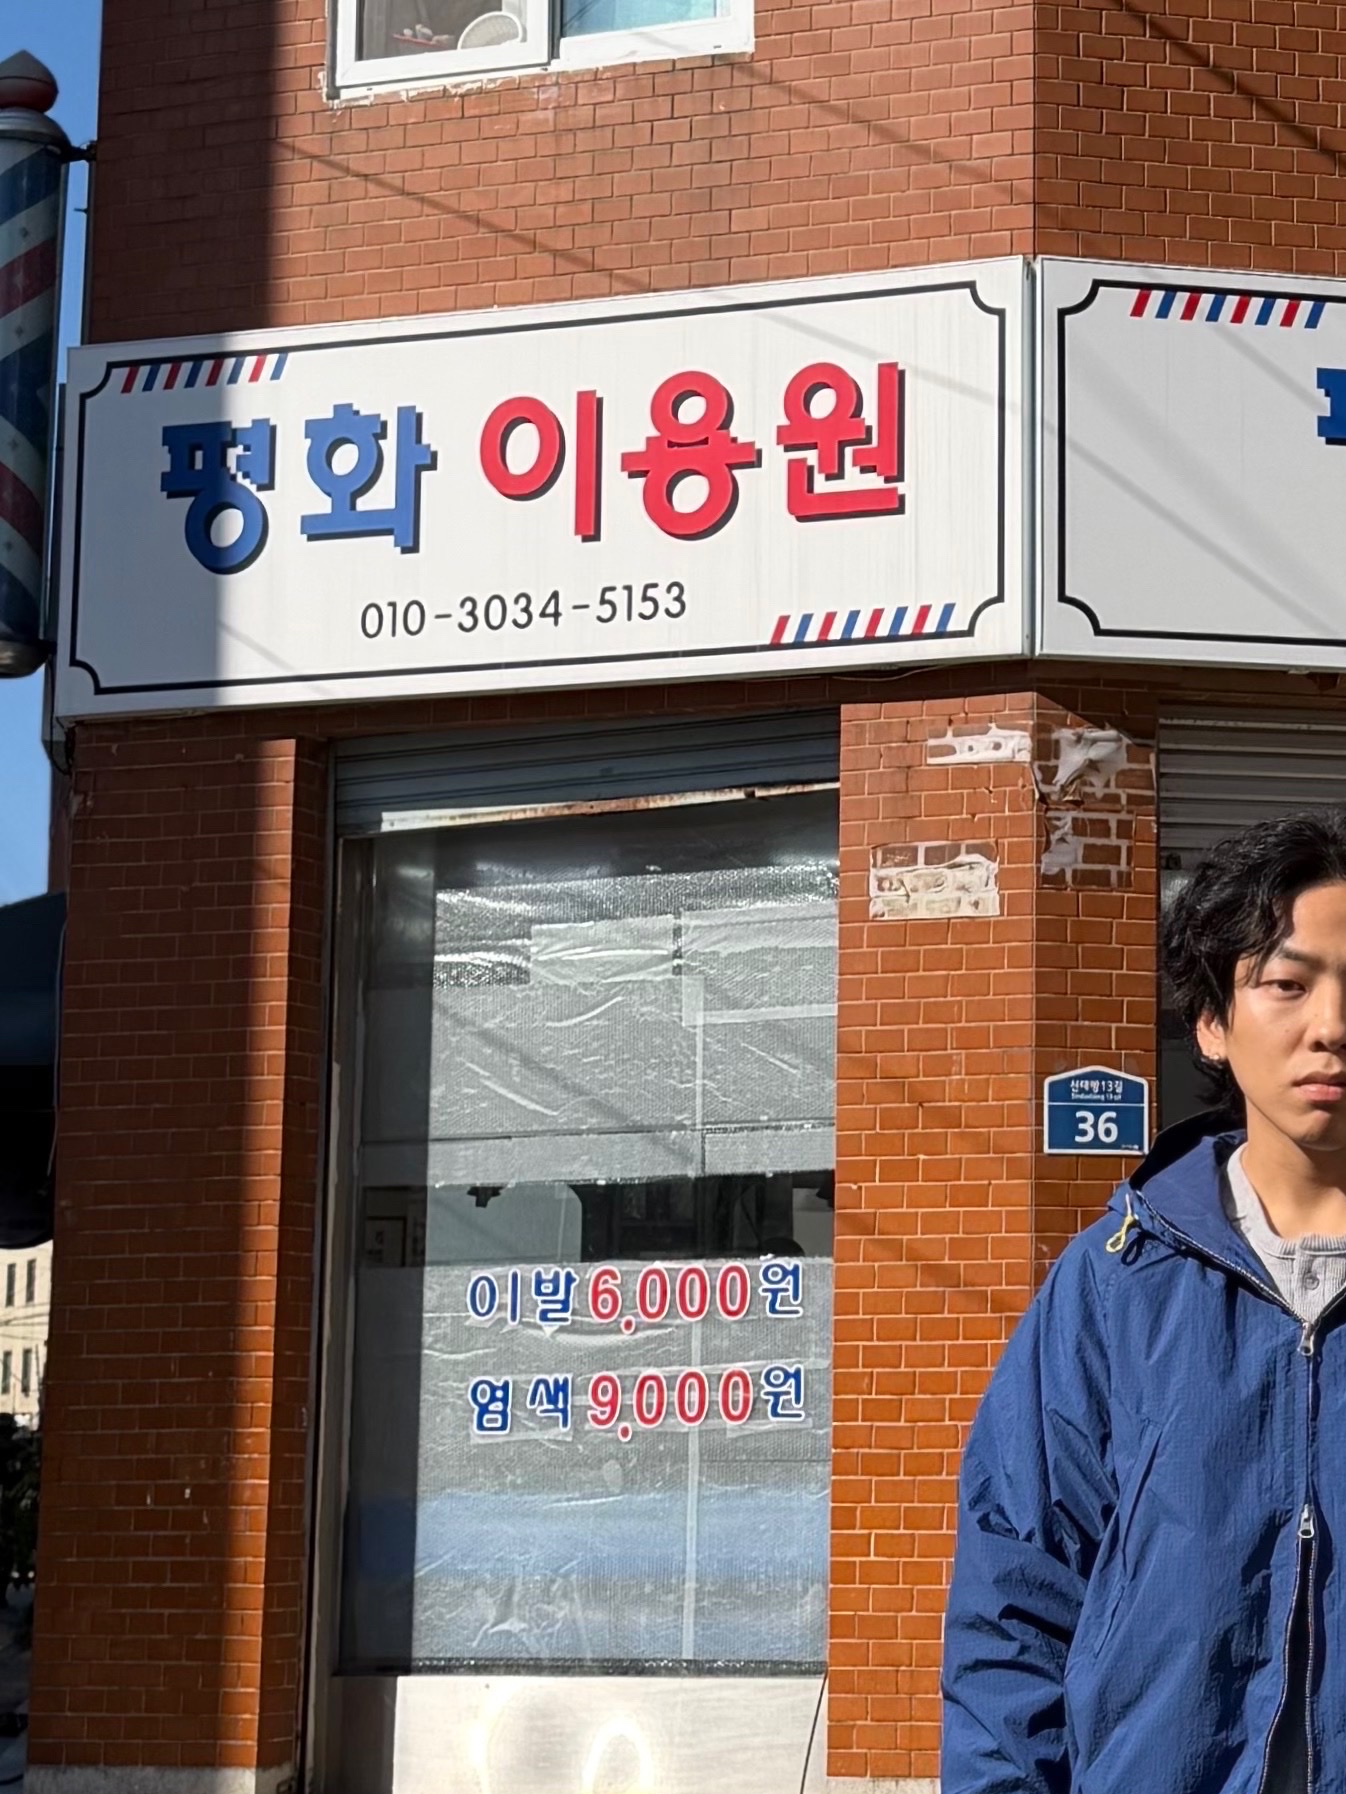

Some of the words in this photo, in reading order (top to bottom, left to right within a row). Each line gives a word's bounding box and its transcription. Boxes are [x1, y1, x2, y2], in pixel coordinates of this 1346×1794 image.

[160, 403, 437, 575] 평화
[480, 362, 906, 541] 이용원
[360, 581, 687, 640] 010-3034-5153
[1075, 1110, 1118, 1143] 36
